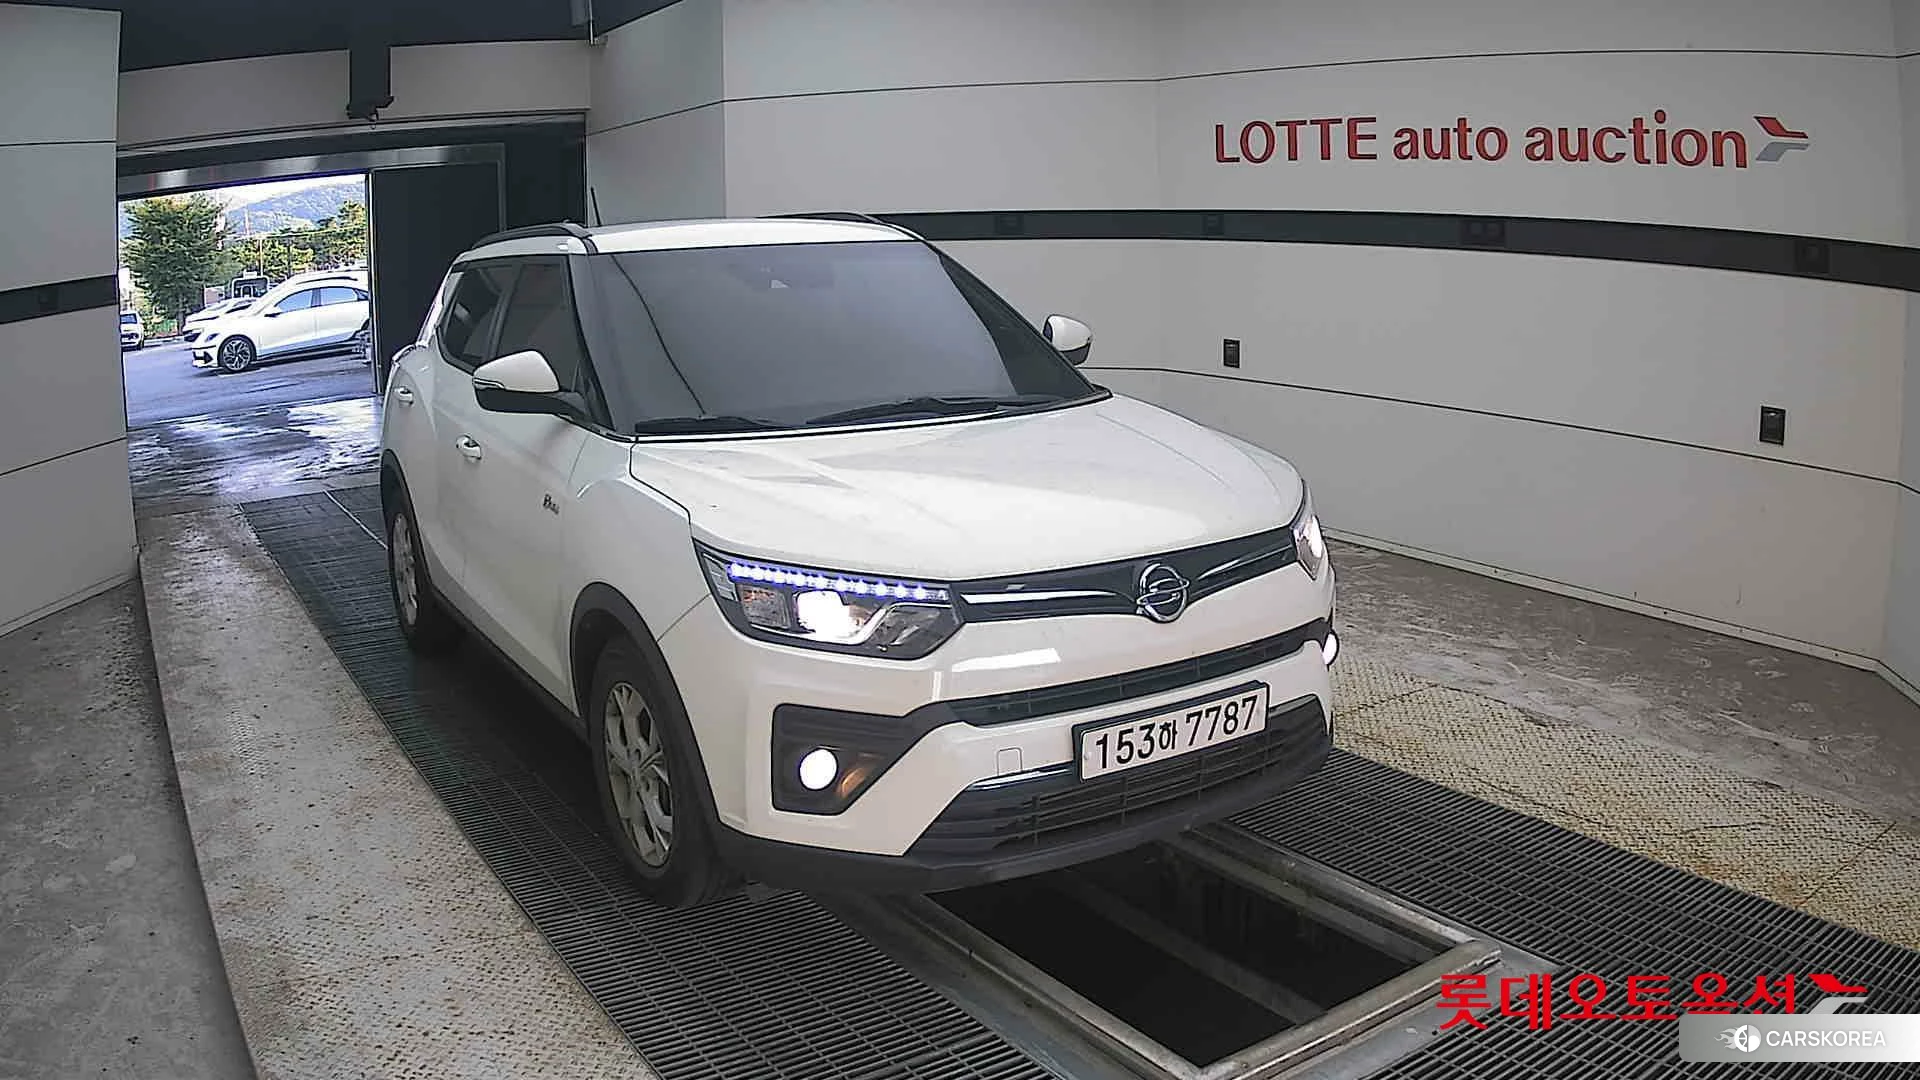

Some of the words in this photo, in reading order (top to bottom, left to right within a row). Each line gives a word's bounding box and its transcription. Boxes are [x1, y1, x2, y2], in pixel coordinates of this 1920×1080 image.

[1215, 116, 1377, 163] LOTTE
[1393, 117, 1508, 161] auto
[1524, 109, 1748, 168] auction
[1095, 719, 1178, 769] 153하
[1185, 695, 1258, 746] 7787
